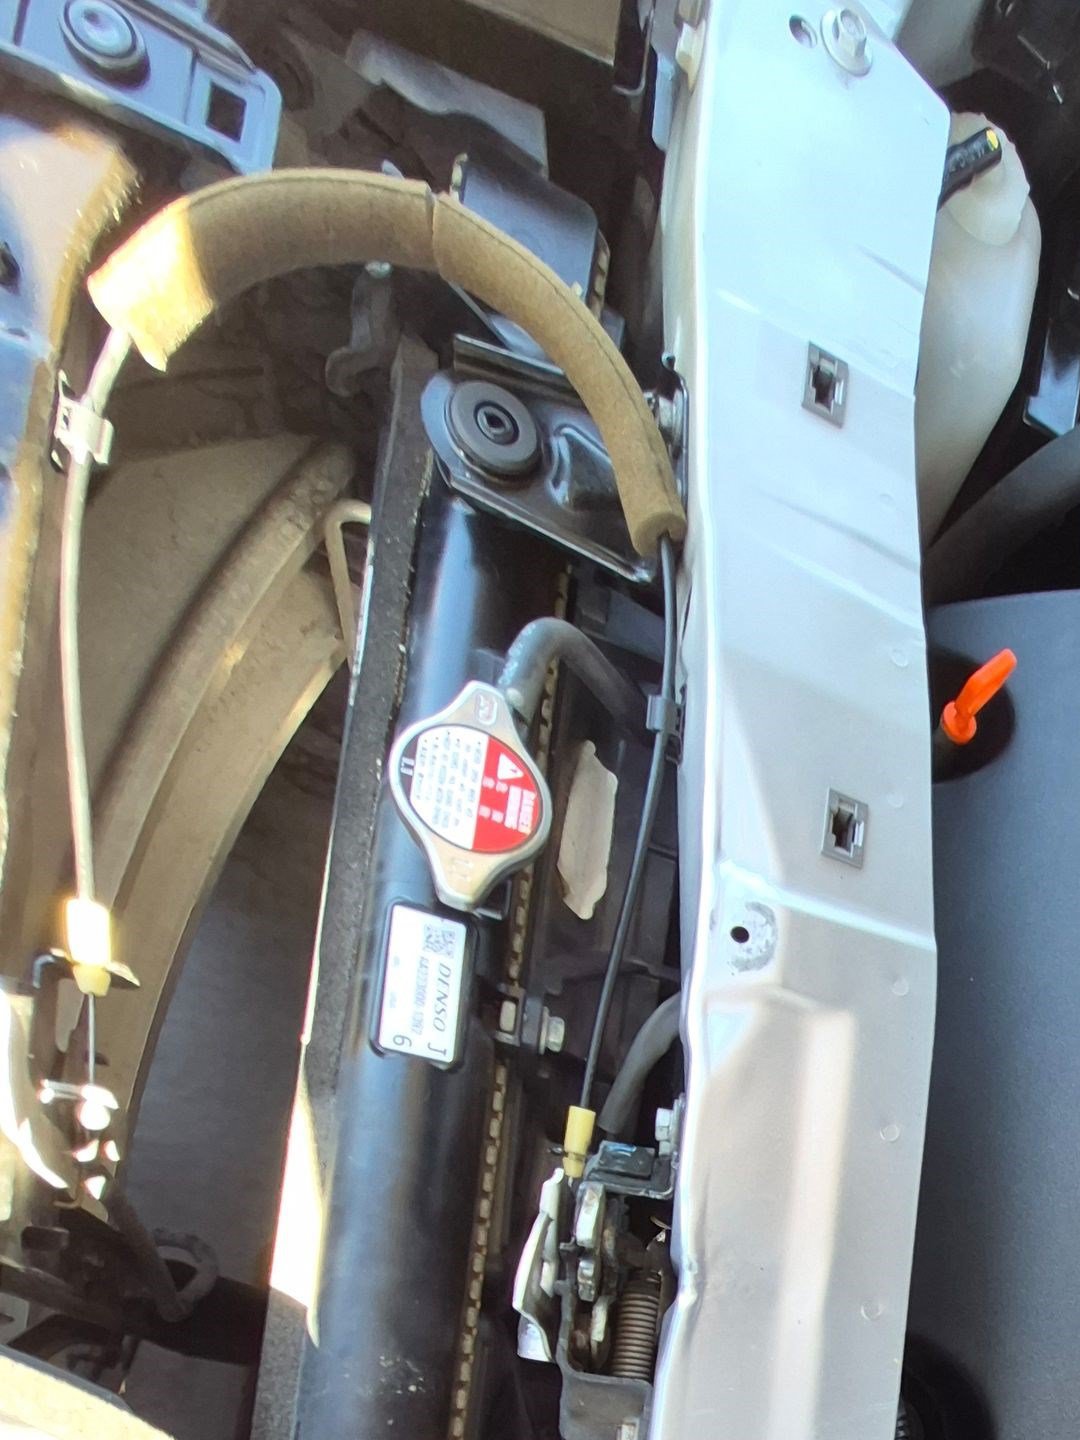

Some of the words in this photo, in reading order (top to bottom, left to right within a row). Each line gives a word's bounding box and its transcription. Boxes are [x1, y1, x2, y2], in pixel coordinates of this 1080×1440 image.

[432, 962, 452, 1033] DENSO
[393, 1034, 412, 1047] 6
[427, 1042, 447, 1056] J
